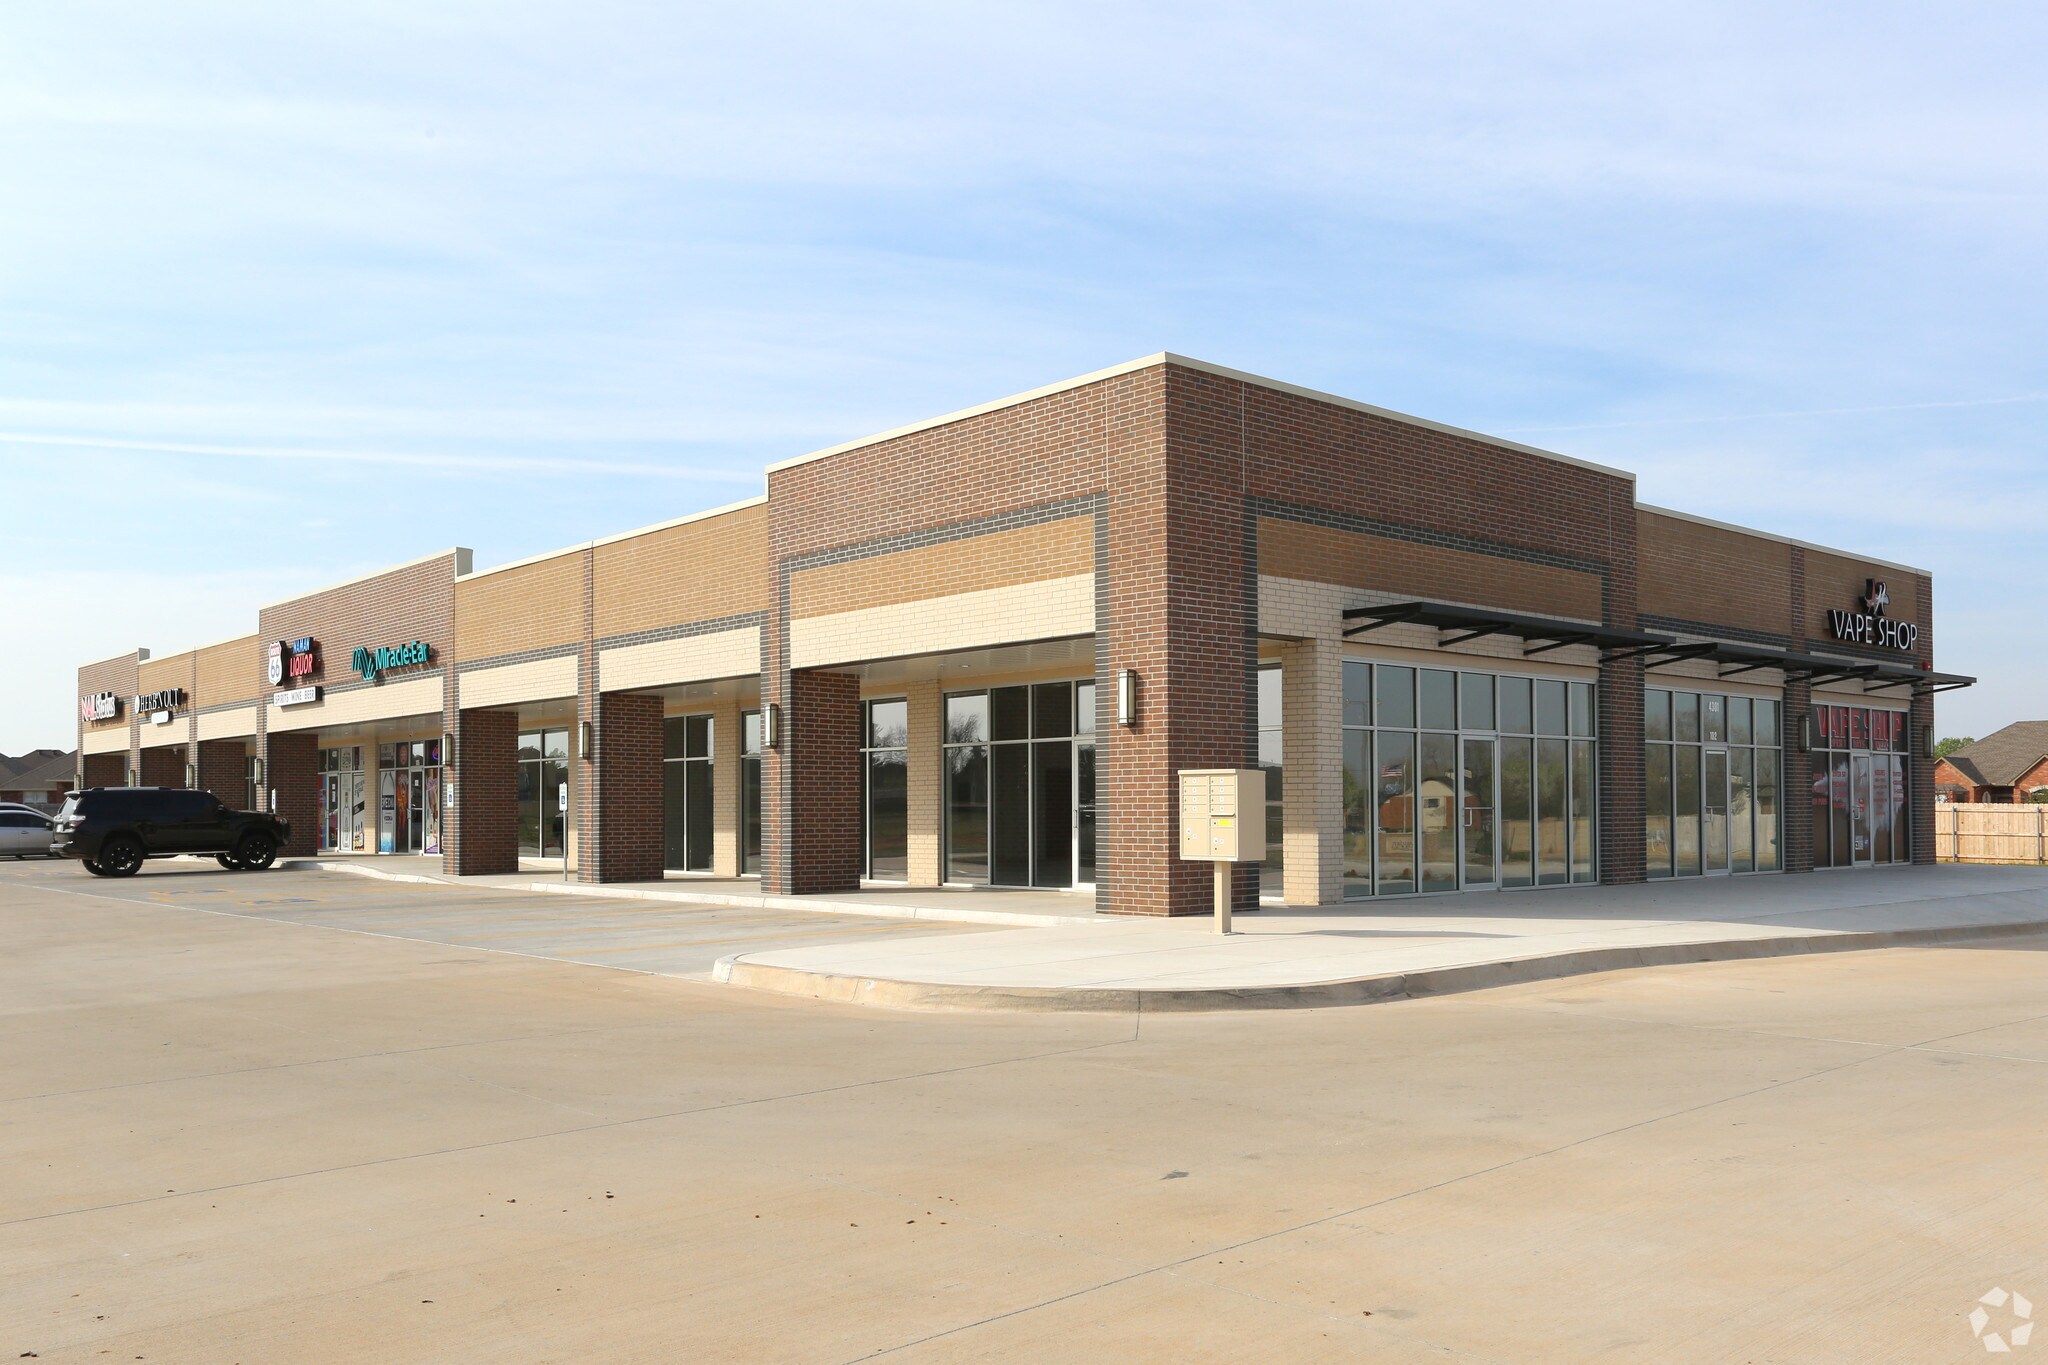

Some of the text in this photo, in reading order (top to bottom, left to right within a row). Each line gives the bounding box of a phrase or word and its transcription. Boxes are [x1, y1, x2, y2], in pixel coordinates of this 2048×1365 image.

[1833, 609, 1918, 650] VAPE SHOP
[271, 658, 280, 678] 66
[290, 653, 313, 677] LIQUOR
[375, 641, 427, 670] Miracle-Ear
[82, 692, 116, 722] NAIL Status
[164, 688, 179, 708] OUT
[275, 688, 315, 705] SPIRITS WINE BEER
[1817, 707, 1861, 739] VAPE
